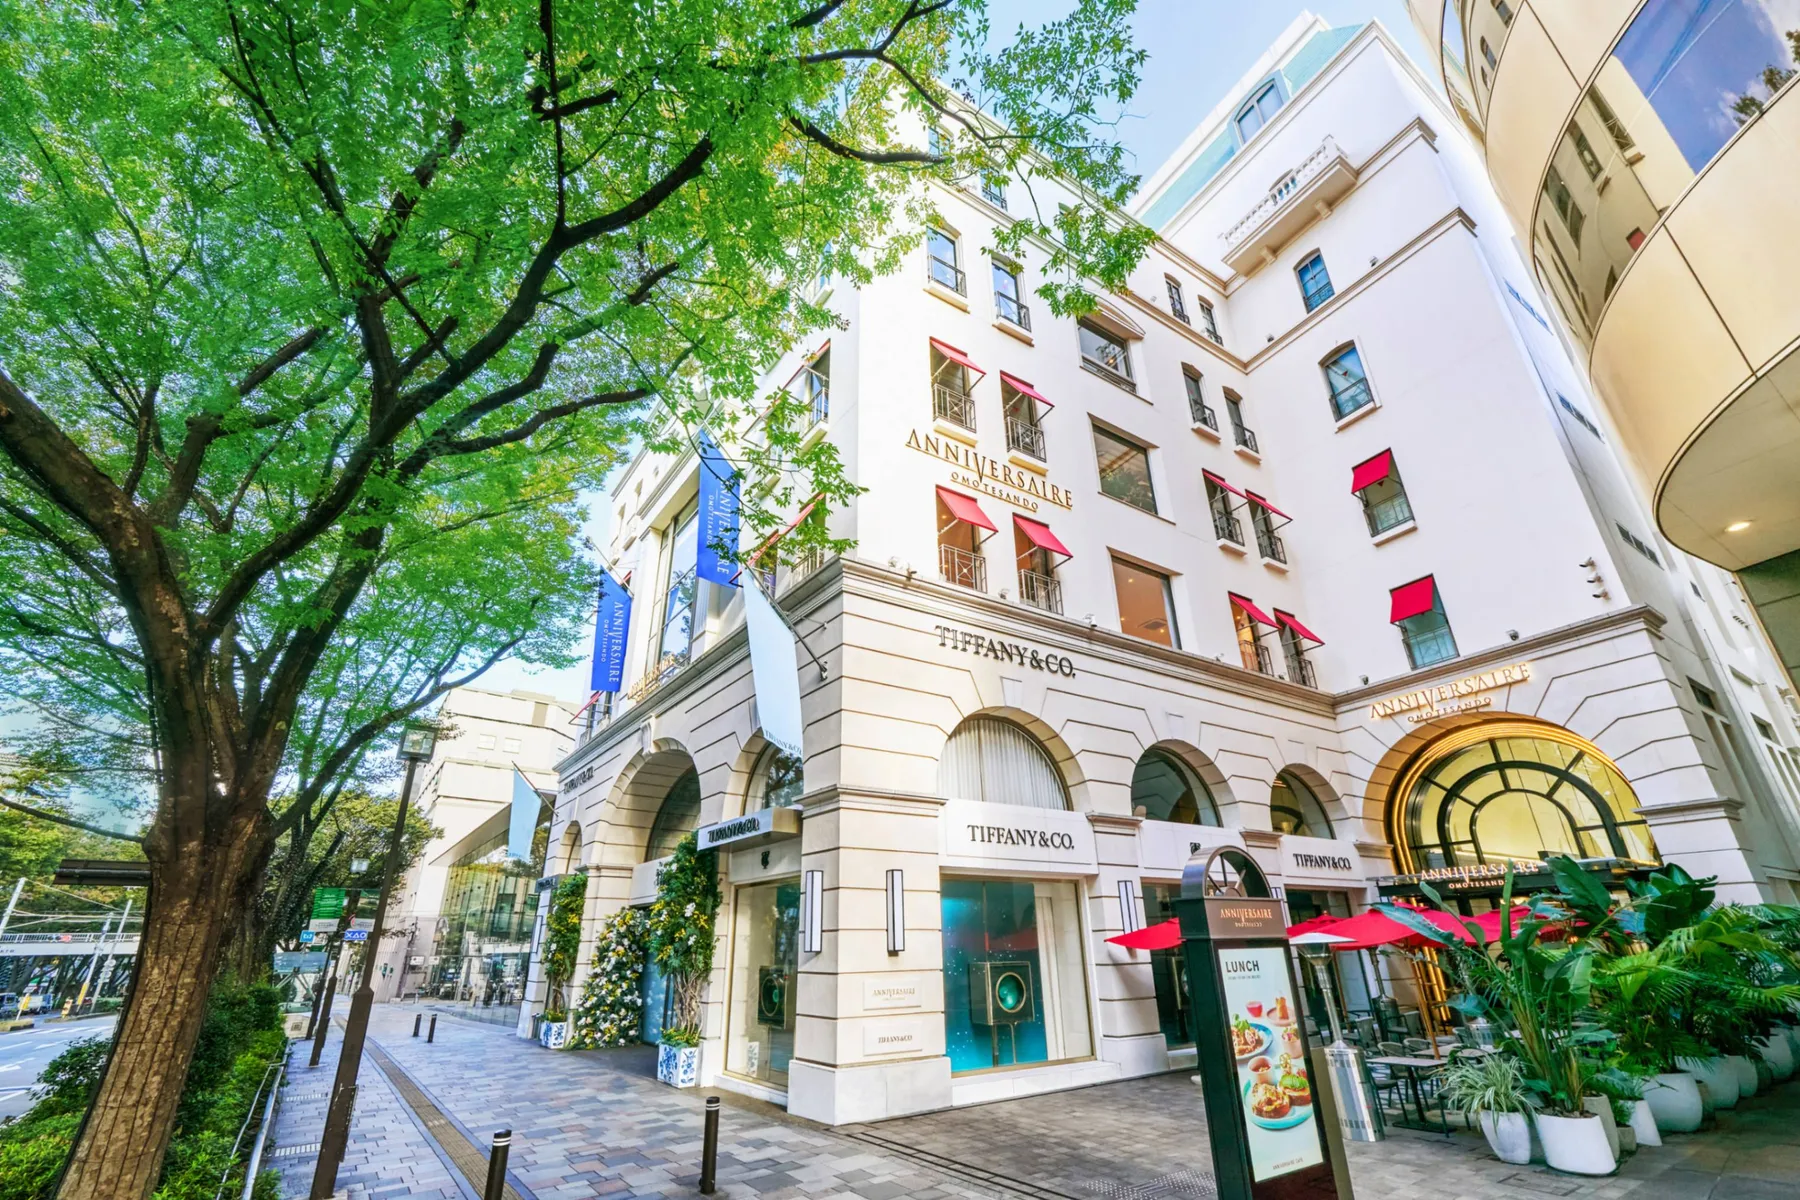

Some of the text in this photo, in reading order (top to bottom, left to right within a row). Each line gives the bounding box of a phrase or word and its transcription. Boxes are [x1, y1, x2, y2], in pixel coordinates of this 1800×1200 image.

[907, 428, 1073, 507] ANNIVERSAIRE
[951, 471, 1039, 510] OMOTESANDO
[608, 601, 624, 682] ANNIVERSAIRE
[934, 625, 1076, 679] TIFFANY&CO.
[1370, 663, 1530, 719] ANNIVERSAIRE
[1407, 696, 1492, 723] OMOTESANDO
[967, 824, 1075, 850] TIFFANY&CO.
[1292, 853, 1352, 870] TIFFANY&CO.
[1421, 861, 1539, 884] ANNIVERSARE
[1448, 879, 1507, 889] OMOTESAND
[1220, 907, 1273, 922] ANNIVERSAIRE
[1225, 960, 1260, 973] LUNCH
